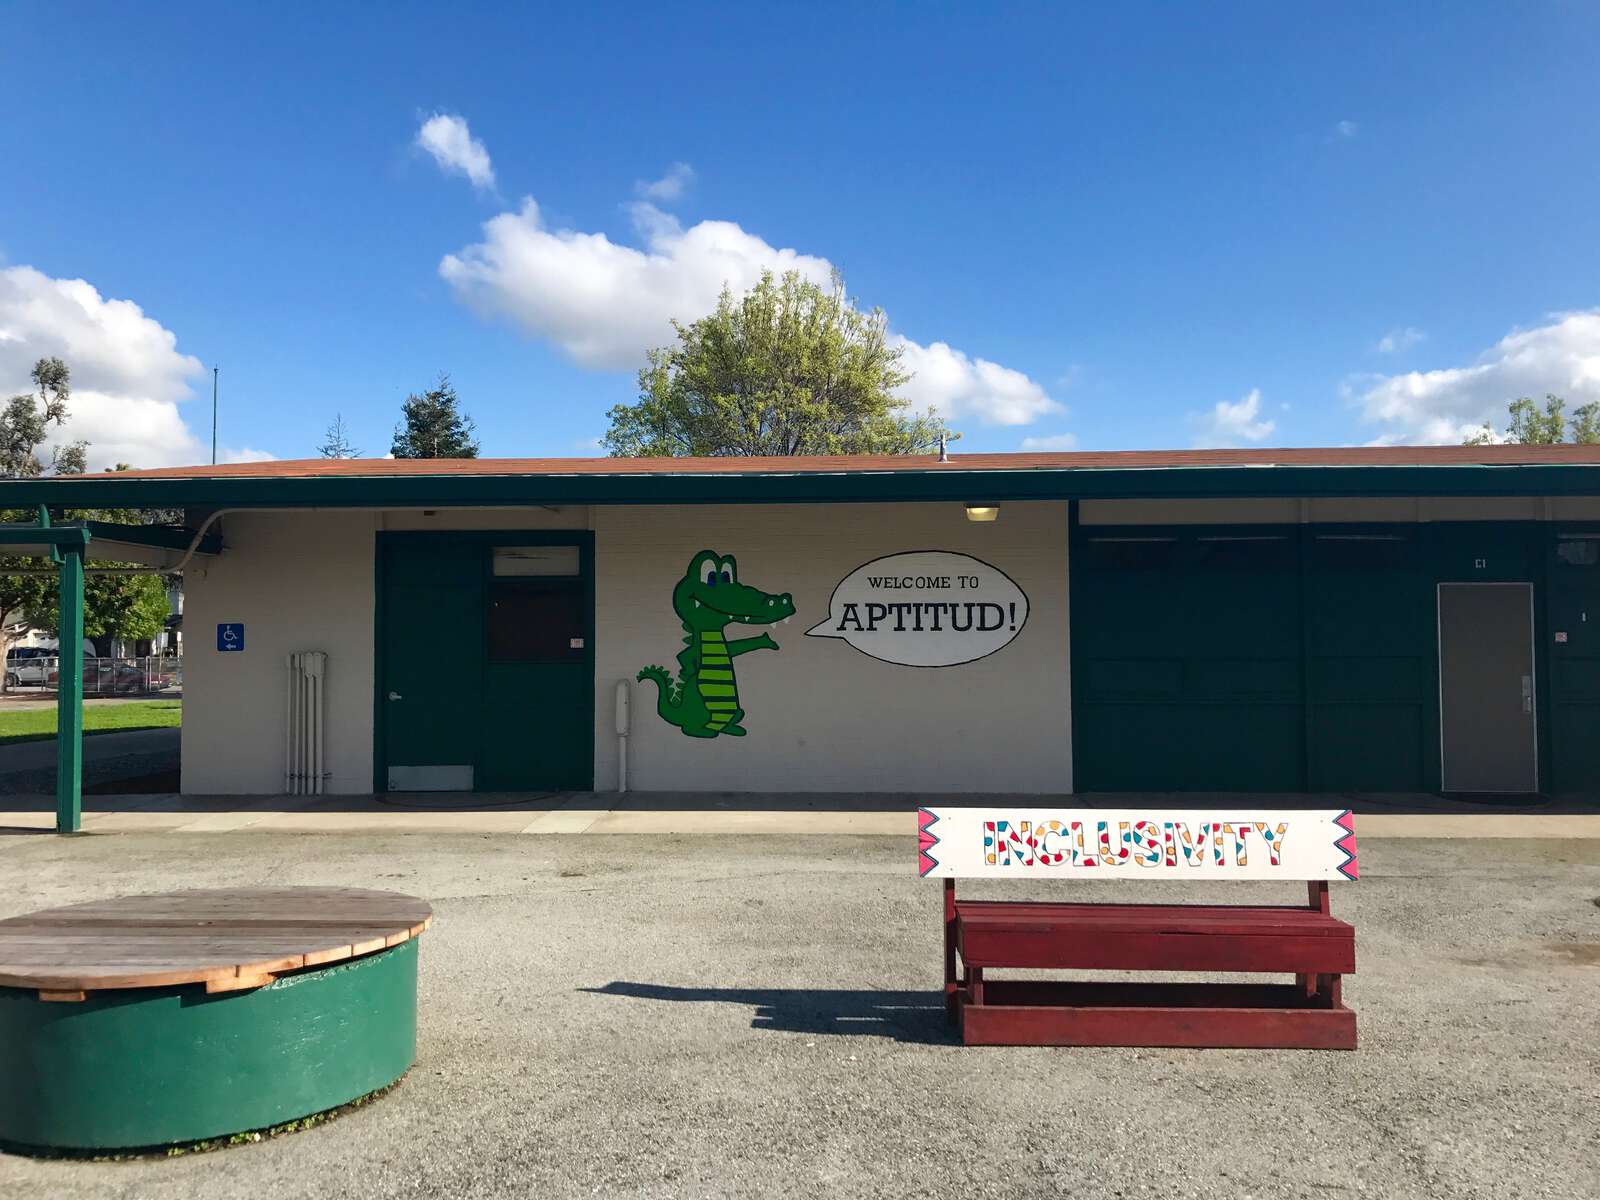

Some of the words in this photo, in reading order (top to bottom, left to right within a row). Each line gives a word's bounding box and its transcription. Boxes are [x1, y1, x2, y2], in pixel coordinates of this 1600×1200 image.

[867, 576, 951, 589] WELCOME
[957, 576, 979, 589] TO
[836, 602, 1016, 632] APTITUD!
[983, 820, 1289, 867] INCLUSIVITY
